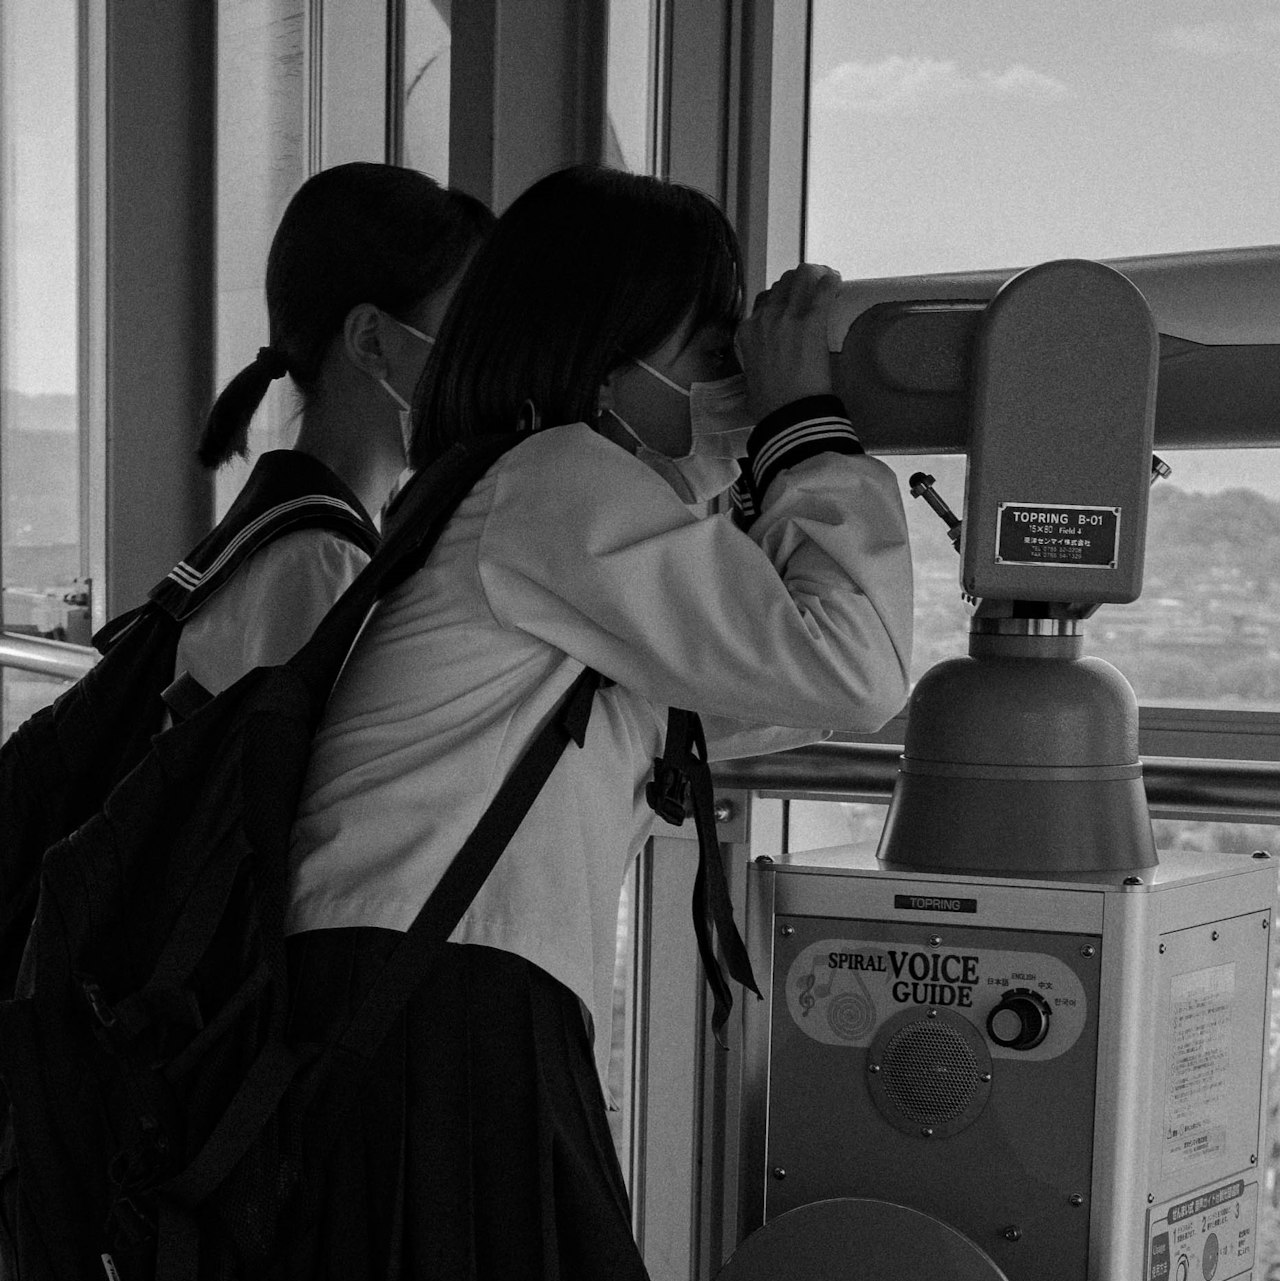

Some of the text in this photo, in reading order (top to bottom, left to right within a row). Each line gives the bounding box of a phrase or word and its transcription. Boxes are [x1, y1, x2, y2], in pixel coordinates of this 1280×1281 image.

[1013, 511, 1103, 526] TOPRING B-01
[1058, 527, 1076, 535] Field
[910, 897, 961, 911] TOPRING
[828, 950, 980, 985] SPIRAL VOICE
[987, 977, 1009, 987] 日本語
[1038, 981, 1054, 990] 中文
[892, 981, 973, 1008] GUIDE
[1054, 998, 1077, 1007] 한국어
